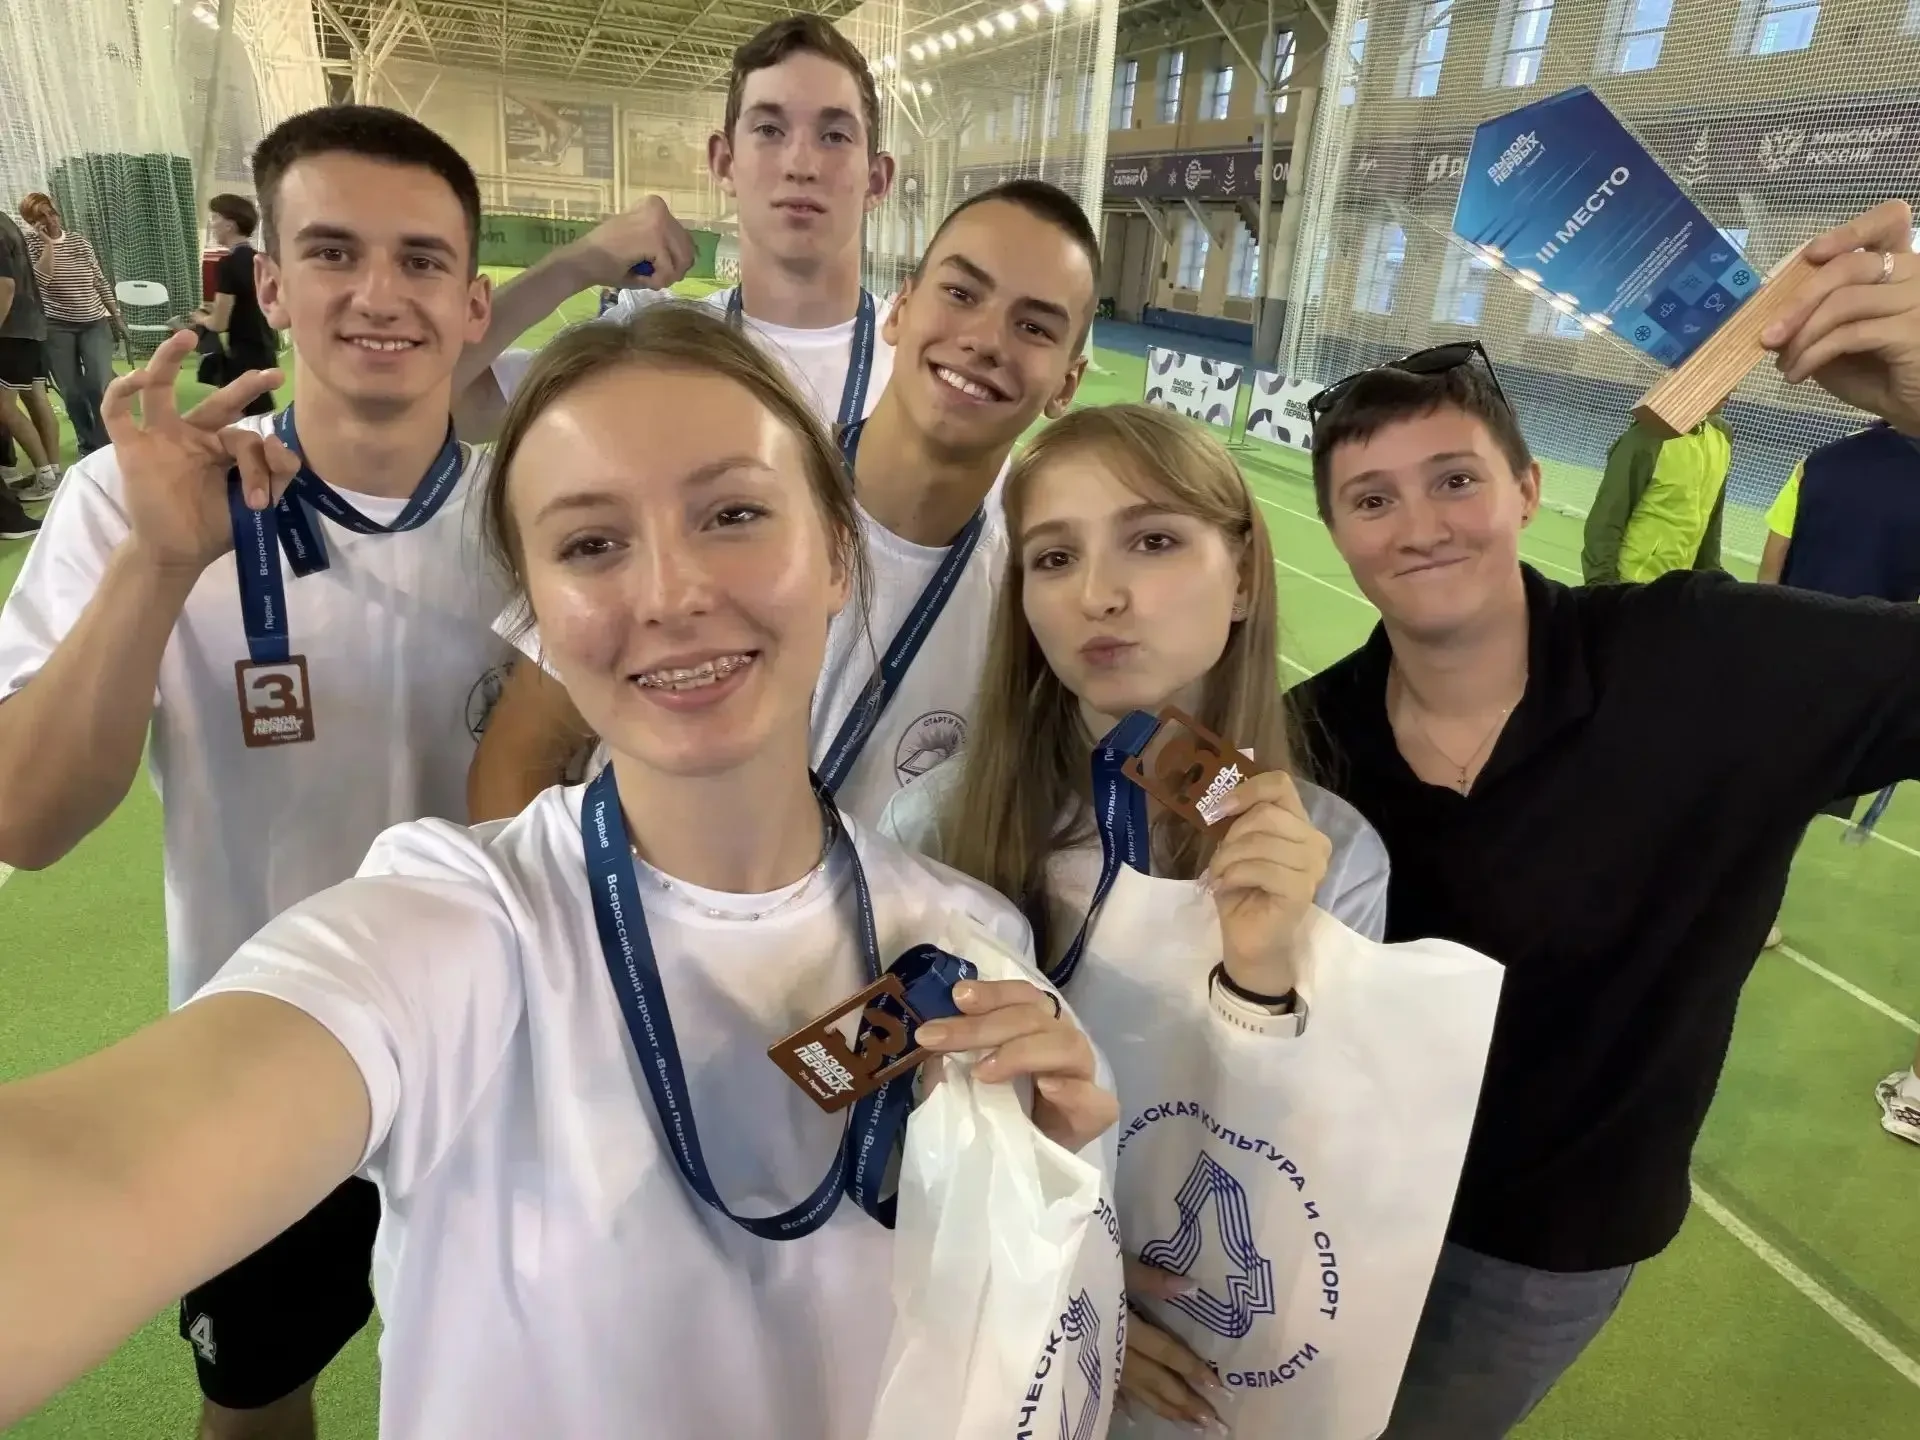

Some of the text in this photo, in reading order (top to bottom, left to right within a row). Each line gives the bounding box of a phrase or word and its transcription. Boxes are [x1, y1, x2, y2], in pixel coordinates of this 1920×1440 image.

[1487, 133, 1529, 179] ВЫЗОВ
[1493, 137, 1540, 187] ПЕРВЫХ
[1535, 166, 1630, 265] III МЕСТО
[1170, 385, 1195, 397] ПЕРВЫХ
[1172, 377, 1193, 389] ВЫЗОВ
[1286, 398, 1309, 411] ВЫЗО
[252, 673, 298, 715] 3
[923, 716, 948, 727] СТАРТ
[1105, 779, 1117, 830] Первых»
[1195, 766, 1230, 812] ВЫЗОВ
[594, 800, 610, 849] Первые
[607, 873, 642, 993] Всероссийский
[637, 993, 660, 1049] проект
[655, 1051, 677, 1110] «Вызов
[793, 1046, 848, 1095] ПЕРВЫХ
[807, 1040, 855, 1084] ВЫЗОВ
[855, 1128, 875, 1184] «Вызов
[1200, 1108, 1307, 1193] КУЛЬТУРА
[1303, 1200, 1321, 1221] И
[1313, 1230, 1339, 1321] СПОРТ
[189, 1312, 217, 1365] 4
[1226, 1342, 1320, 1388] ОБЛАСТИ
